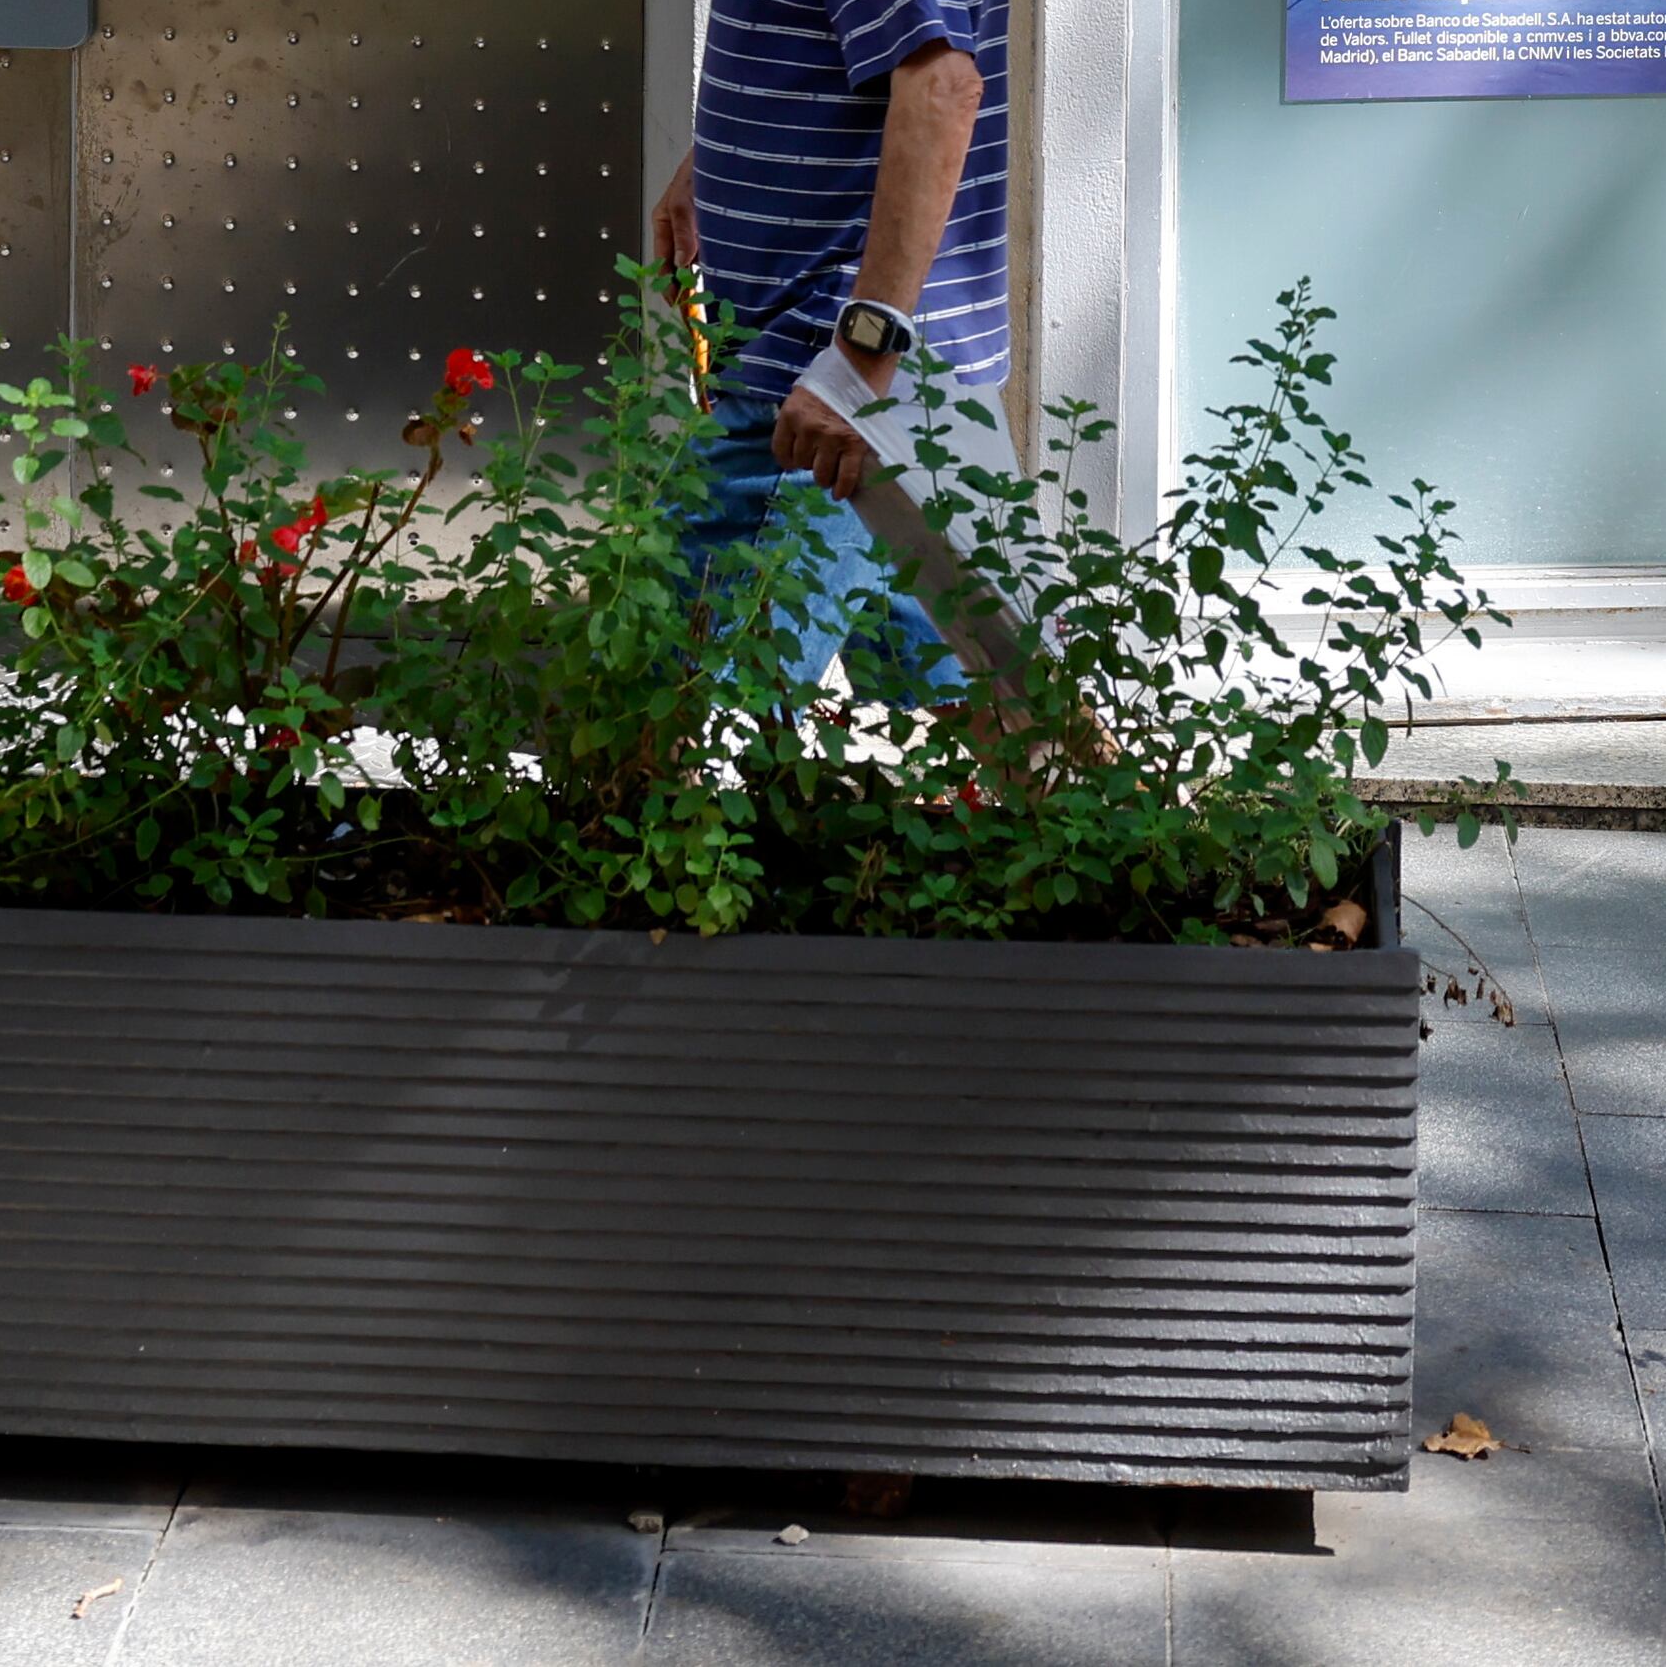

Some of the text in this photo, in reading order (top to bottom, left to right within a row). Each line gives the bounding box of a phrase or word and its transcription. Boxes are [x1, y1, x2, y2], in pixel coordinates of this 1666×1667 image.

[1321, 16, 1372, 29] L'oferta
[1375, 15, 1413, 28] sobre
[1417, 14, 1460, 27] Banco
[1462, 14, 1479, 27] de
[1482, 13, 1545, 27] Sabadell,
[1547, 13, 1575, 25] S.A.
[1577, 13, 1593, 25] ha
[1596, 13, 1630, 25] estat
[1321, 33, 1337, 46] de
[1343, 33, 1388, 45] Valors.
[1395, 31, 1431, 44] Fullet
[1437, 30, 1508, 47] disponible
[1513, 33, 1521, 43] a
[1527, 32, 1583, 43] cnmv.es
[1597, 33, 1605, 42] a
[1321, 49, 1378, 65] Madrid),
[1383, 49, 1394, 62] el
[1398, 49, 1433, 61] Banc
[1437, 47, 1499, 61] Sabadell,
[1503, 47, 1515, 60] la
[1519, 47, 1563, 59] CNMV
[1574, 47, 1592, 59] les
[1596, 46, 1660, 59] Societats
